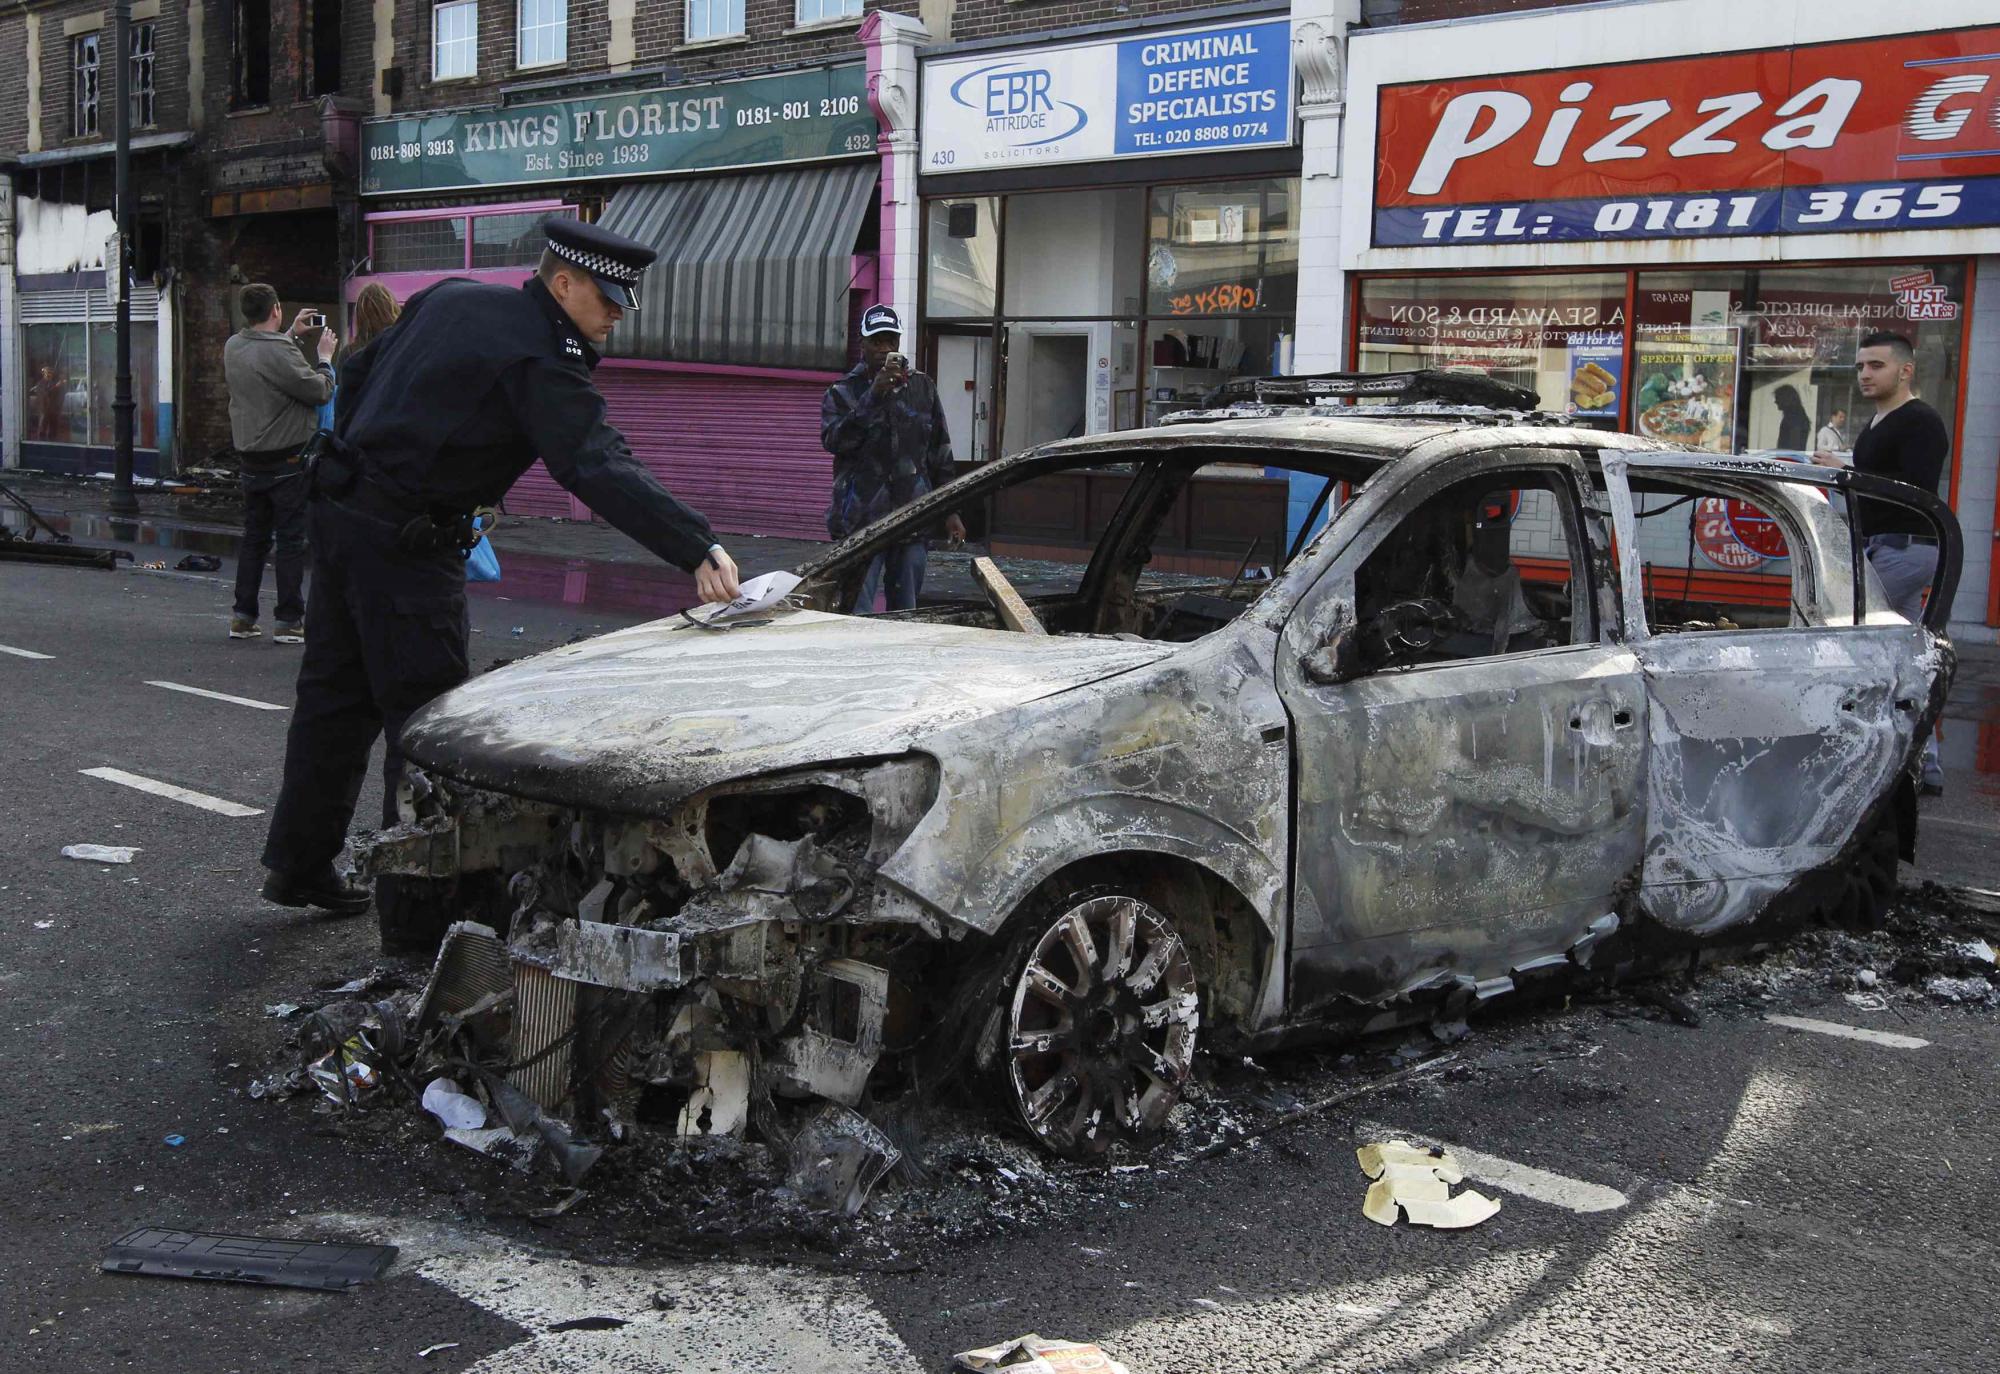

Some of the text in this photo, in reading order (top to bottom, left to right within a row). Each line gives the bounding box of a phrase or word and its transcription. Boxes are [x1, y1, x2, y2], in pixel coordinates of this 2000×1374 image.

[1141, 32, 1257, 66] CRIMINAL
[1148, 63, 1249, 95] DEFENCE
[986, 68, 1054, 117] EBR
[736, 96, 859, 127] 0181-801 2106
[1127, 89, 1276, 124] SPECIALISTS
[464, 96, 725, 153] KINGS FLORIST
[985, 113, 1046, 133] ATTRIDGE
[1134, 122, 1267, 147] TEL: 020 8808 0774
[1407, 75, 2000, 196] Pizza G
[370, 139, 454, 161] 0181-808 3913
[844, 133, 870, 152] 432
[984, 145, 1060, 160] SOLICITORS
[525, 144, 650, 172] Est. Since 1933
[932, 150, 955, 166] 430
[1421, 184, 1964, 239] TEL: 0181 365
[1901, 289, 1944, 303] JUST
[1910, 304, 1943, 317] EAT
[1640, 354, 1734, 364] SPECIAL OFFER
